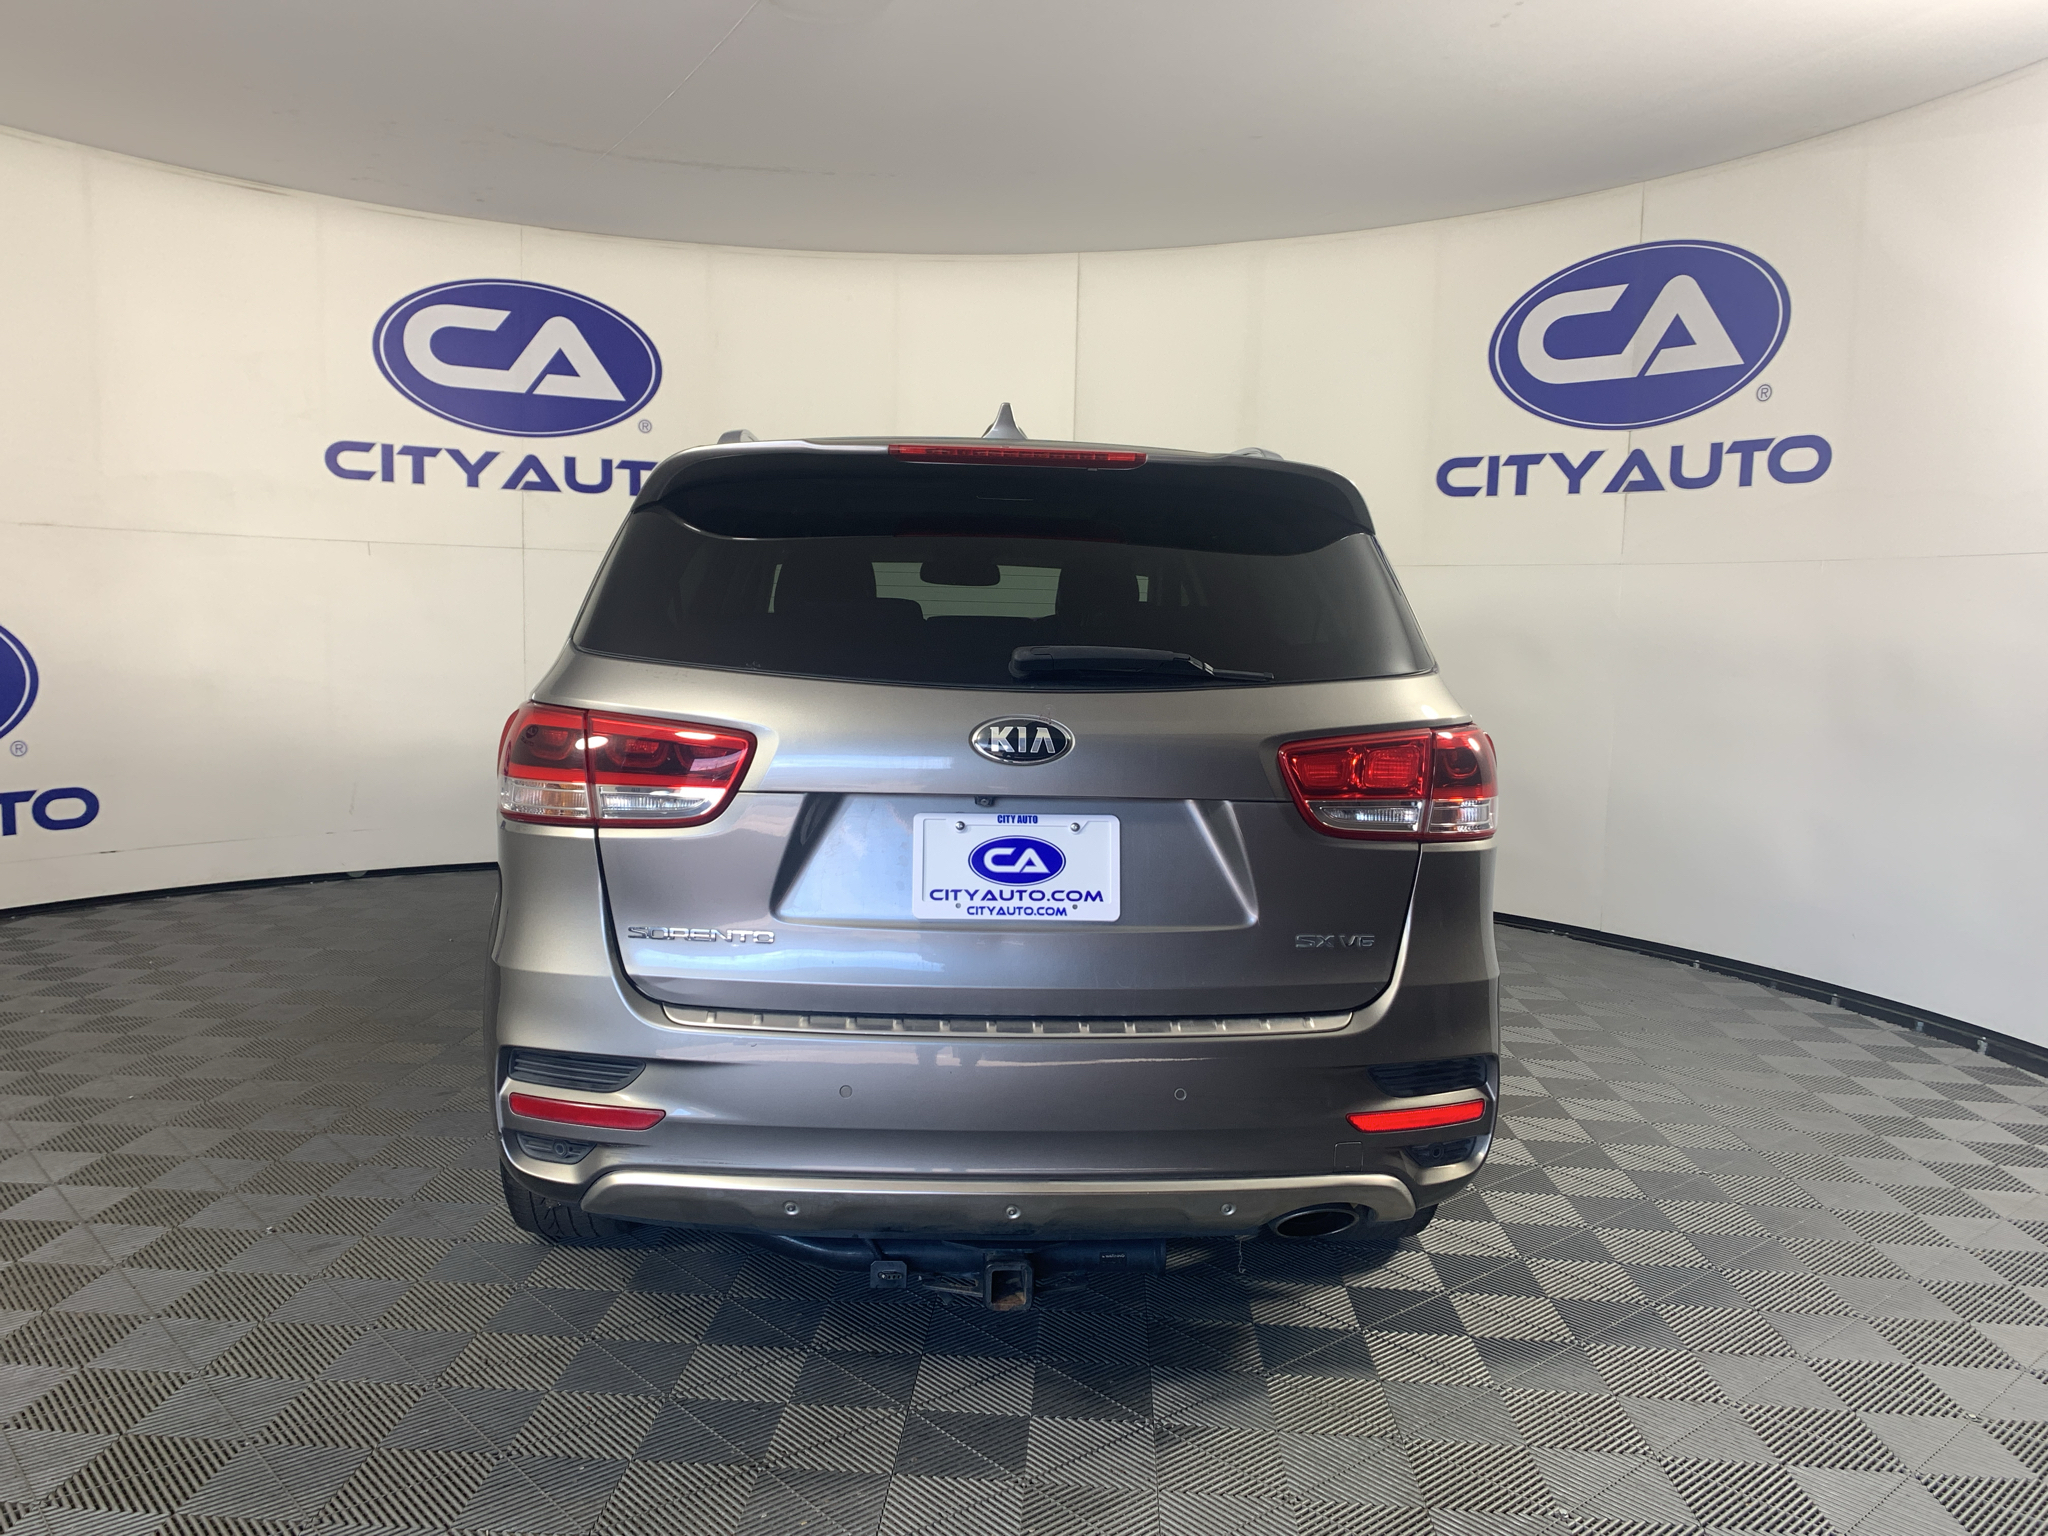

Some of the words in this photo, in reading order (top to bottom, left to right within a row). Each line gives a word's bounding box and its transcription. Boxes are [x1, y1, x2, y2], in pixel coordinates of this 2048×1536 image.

[1518, 273, 1745, 385] CA
[403, 303, 626, 402] CA
[501, 454, 659, 496] AUT
[990, 726, 1056, 754] KIA
[0, 786, 100, 836] TO
[997, 814, 1016, 825] CITY
[1017, 814, 1039, 825] AUTO
[984, 846, 1051, 874] CA
[929, 888, 1104, 903] CITYAUTO.COM
[966, 905, 1068, 917] CITYAUTO.COM
[627, 926, 776, 944] SORENTO
[1295, 933, 1335, 949] SX
[1339, 934, 1376, 948] V6
